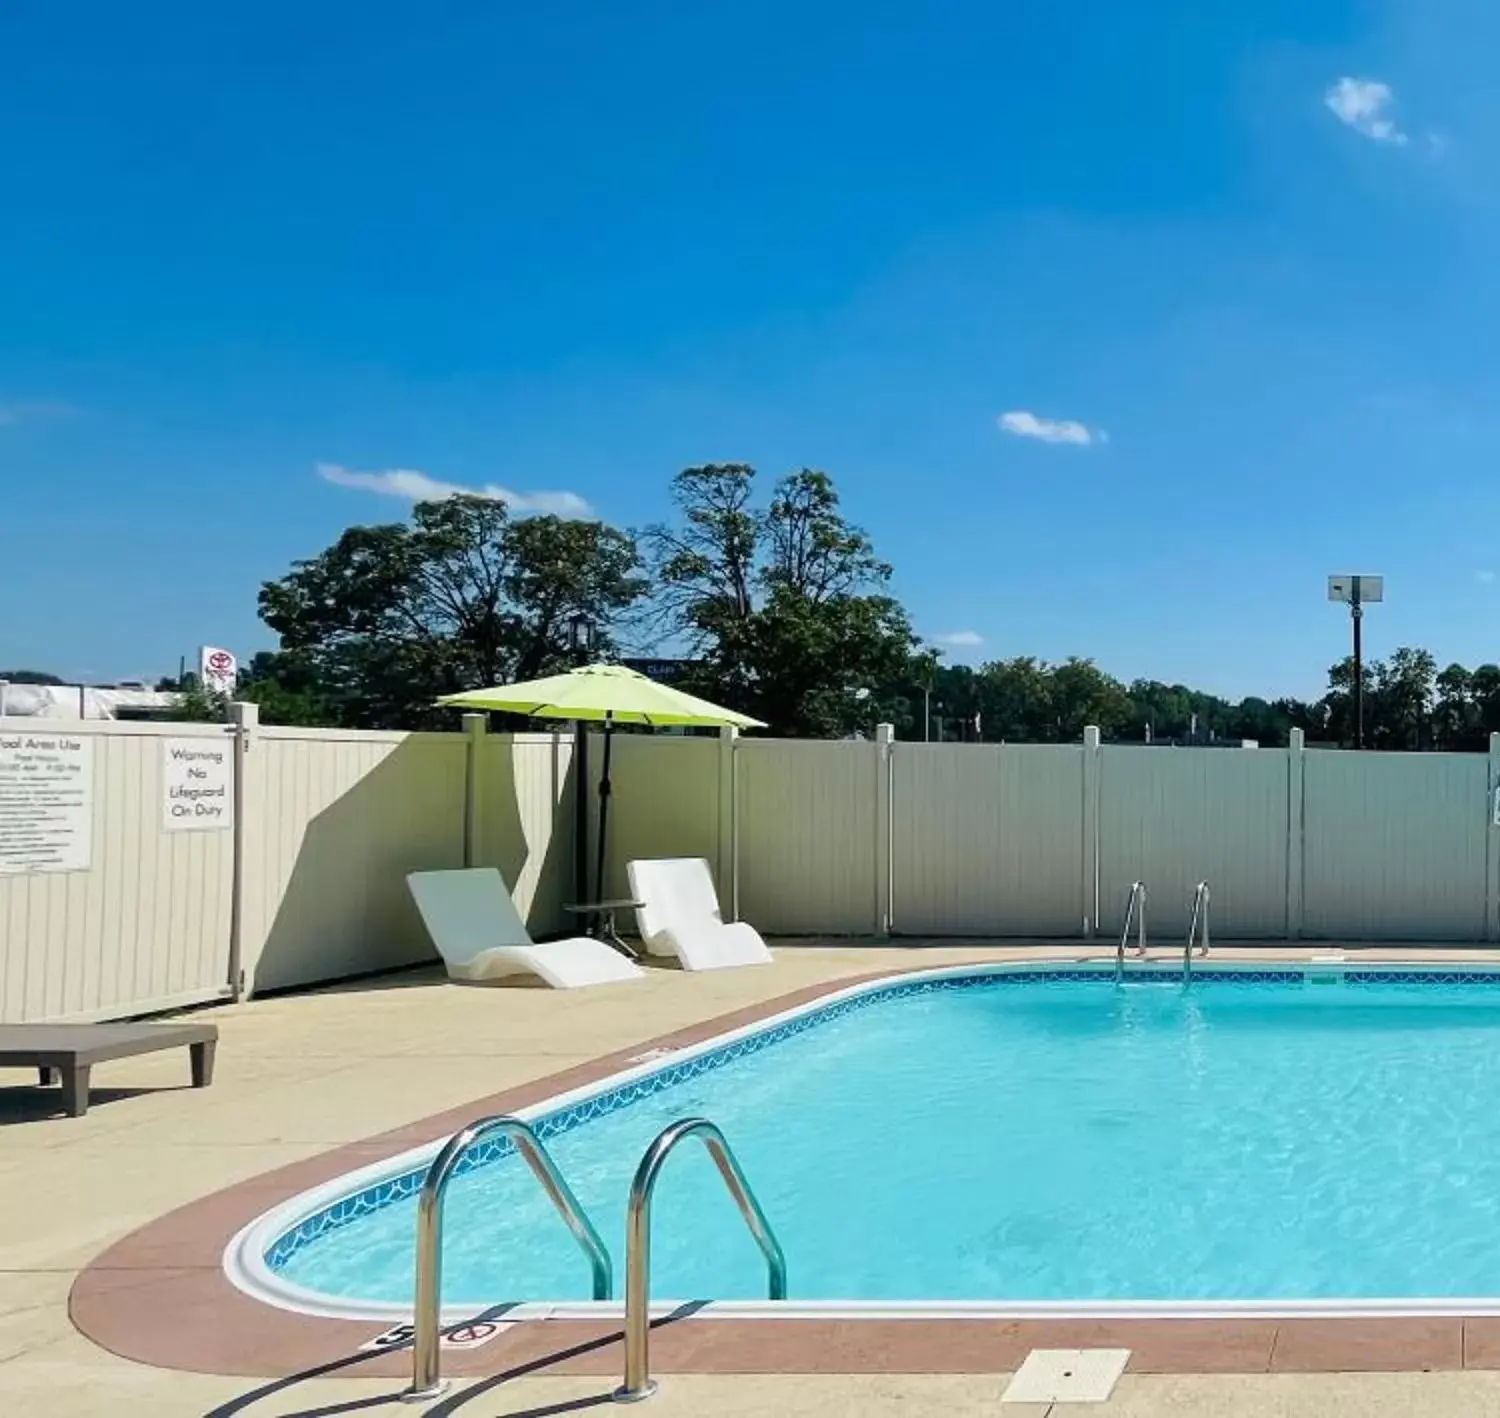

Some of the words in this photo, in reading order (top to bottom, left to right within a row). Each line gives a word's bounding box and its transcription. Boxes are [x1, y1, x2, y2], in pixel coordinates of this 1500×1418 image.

[0, 736, 22, 749] ool
[26, 738, 55, 750] Area
[60, 739, 80, 751] Use
[170, 748, 223, 764] Warning
[187, 767, 207, 779] No
[169, 784, 225, 800] Lifeguard
[171, 804, 192, 817] On
[195, 803, 222, 818] Duty
